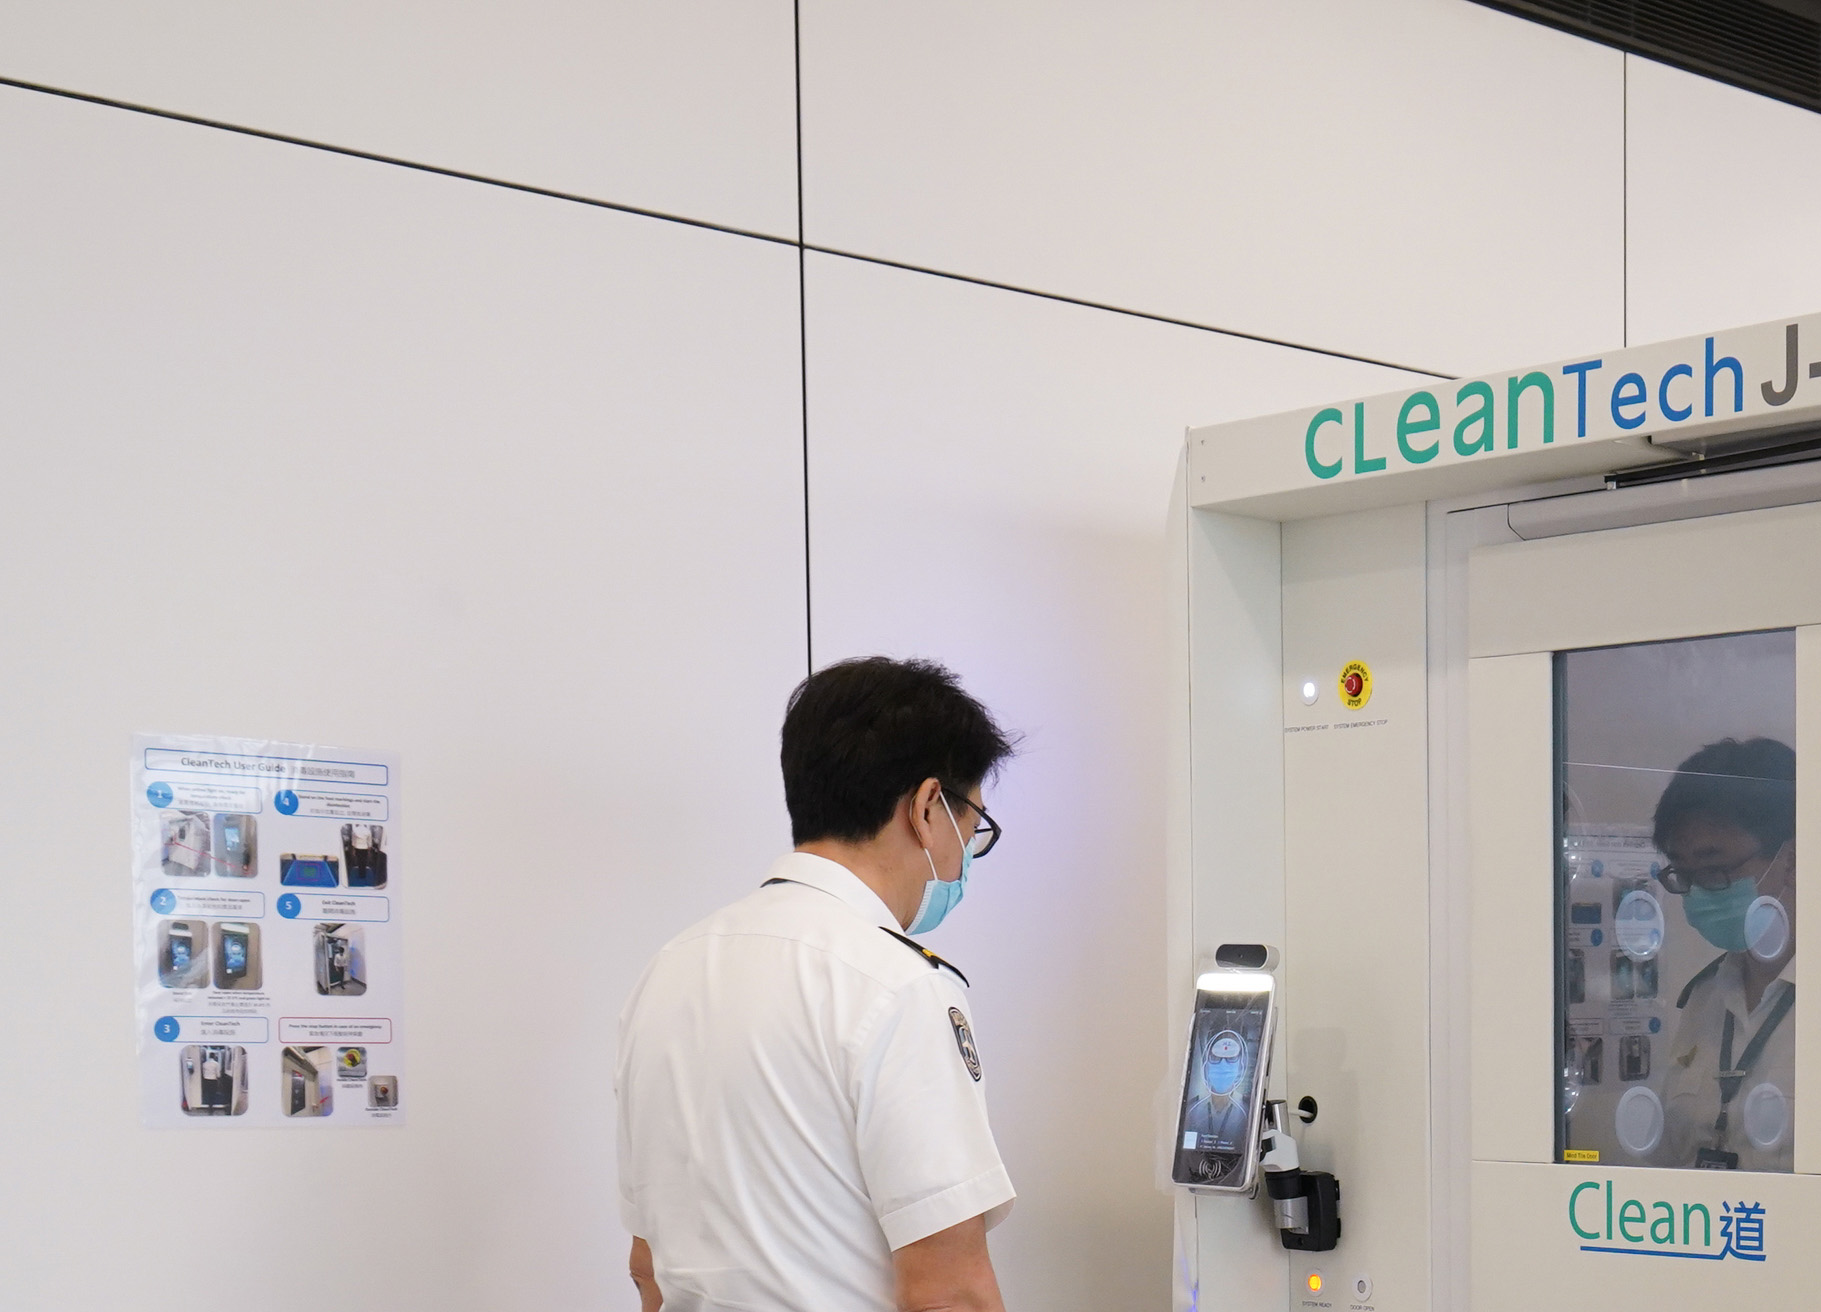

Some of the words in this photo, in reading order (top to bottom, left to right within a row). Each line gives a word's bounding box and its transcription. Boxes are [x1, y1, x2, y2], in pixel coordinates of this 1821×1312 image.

[1340, 663, 1369, 684] EMERGENCY
[1347, 697, 1362, 707] STOP
[180, 757, 231, 769] CleanTech
[233, 761, 256, 771] User
[257, 762, 286, 773] Guide
[284, 901, 293, 910] 5
[163, 1024, 171, 1033] 3
